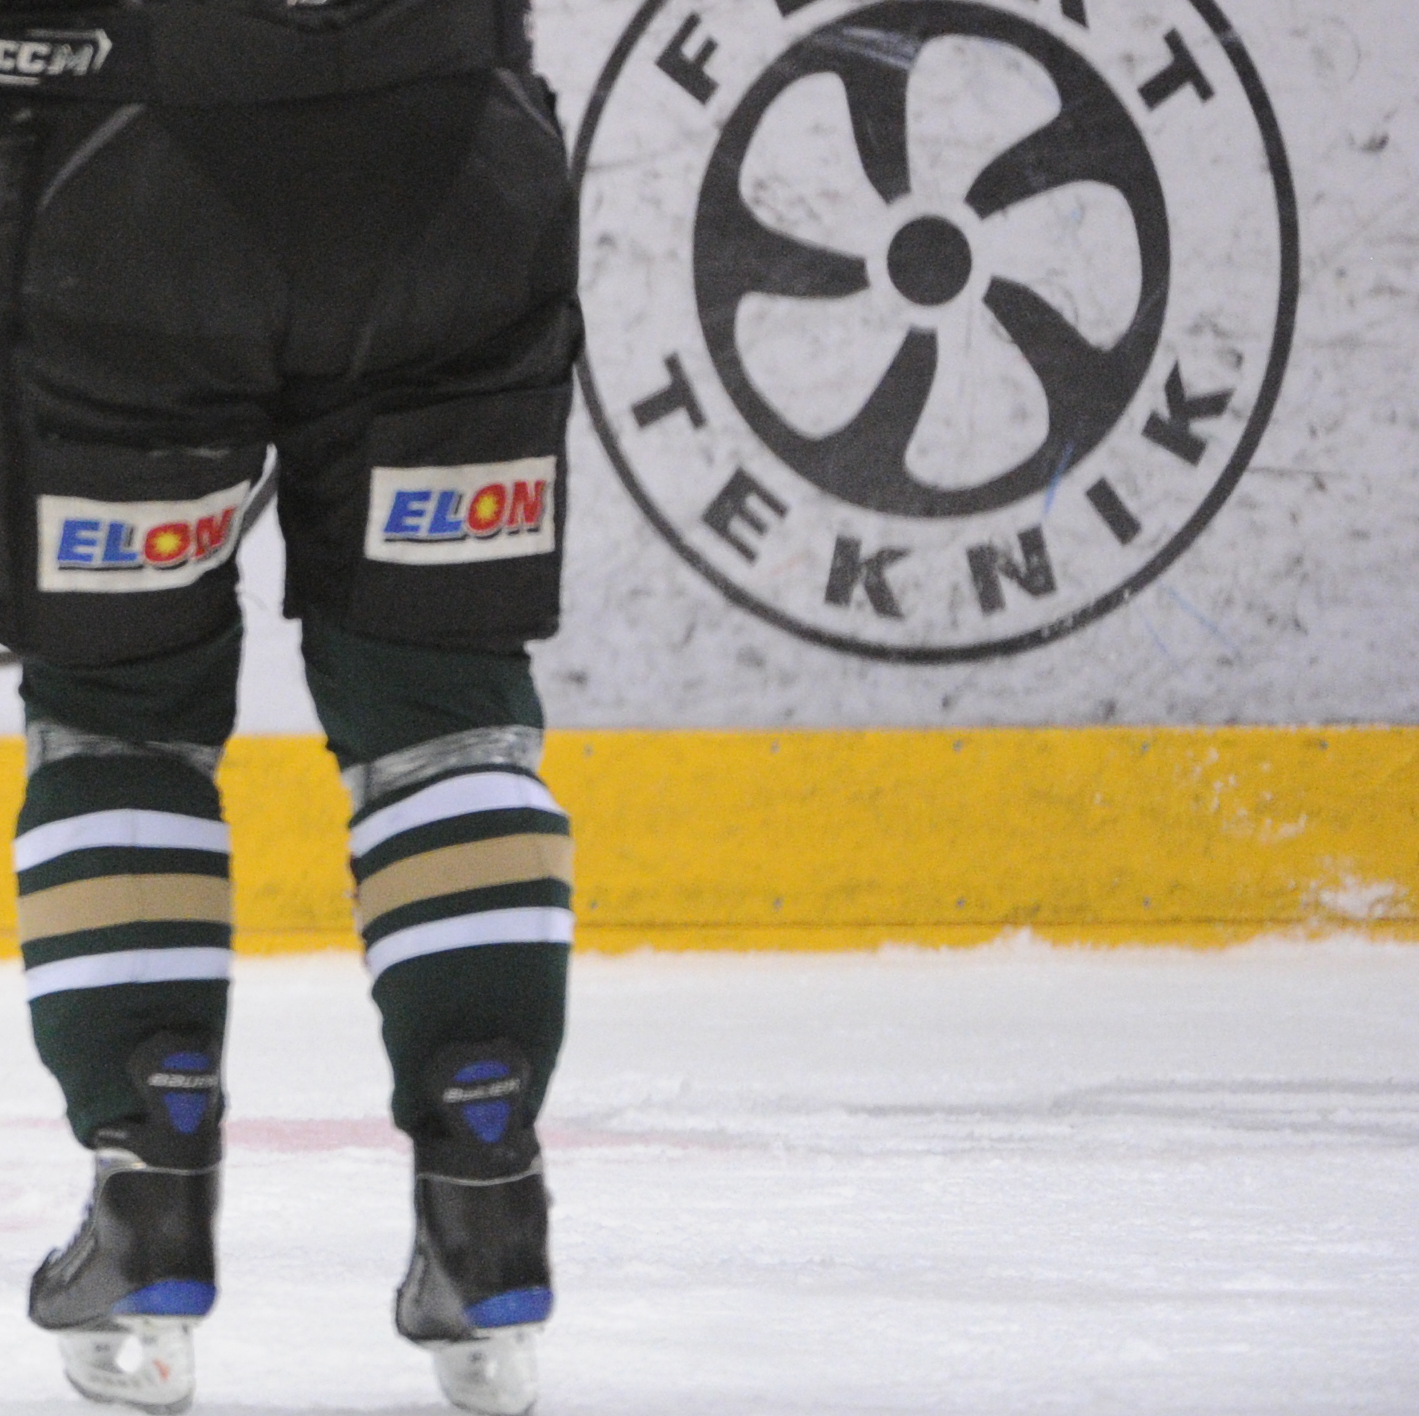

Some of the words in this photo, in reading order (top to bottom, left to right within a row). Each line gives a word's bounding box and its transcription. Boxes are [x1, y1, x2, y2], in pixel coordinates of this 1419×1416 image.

[383, 479, 547, 544] ELON
[631, 352, 1236, 620] TEKNIK
[56, 506, 237, 570] ELON
